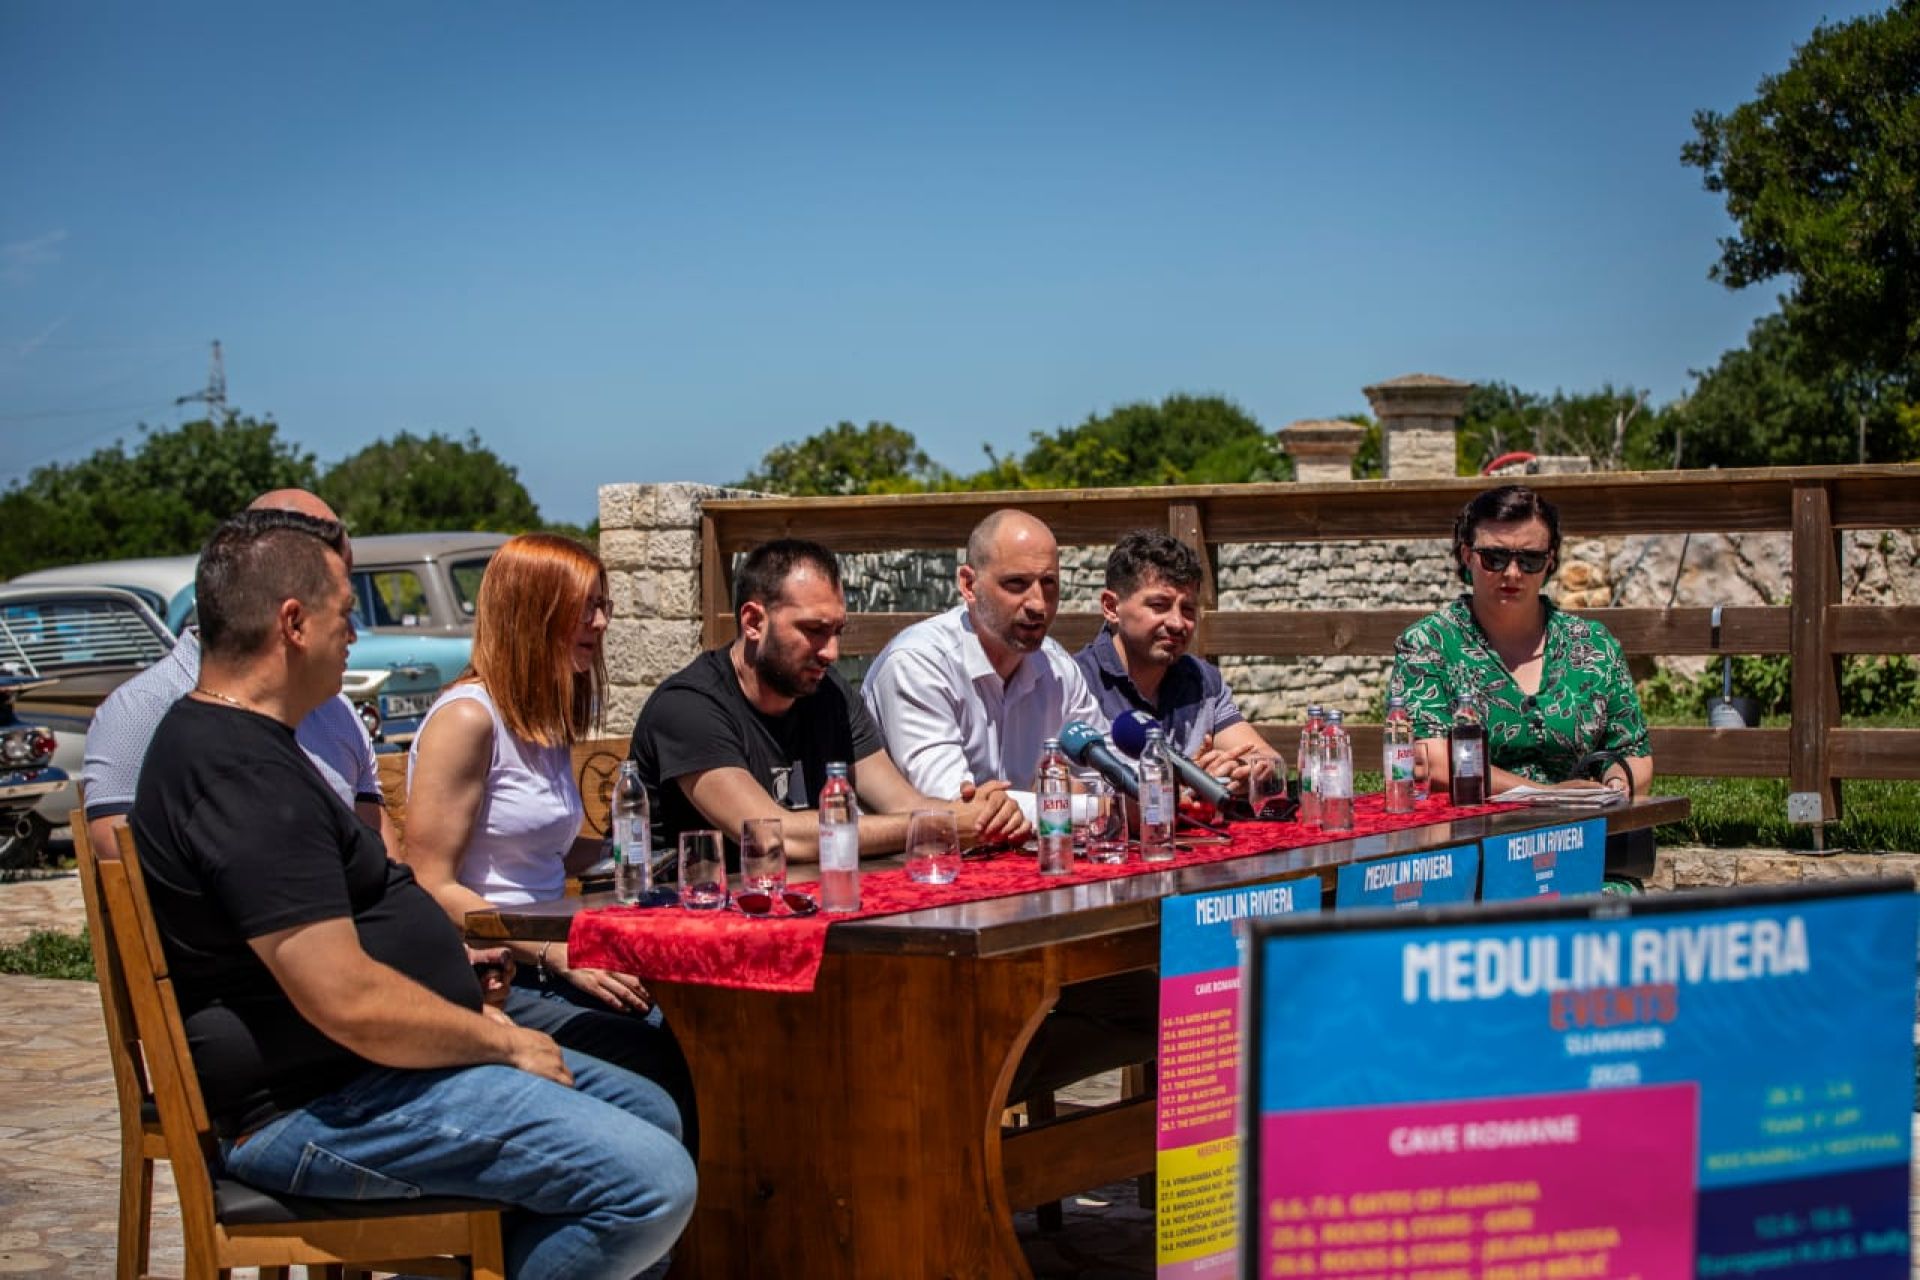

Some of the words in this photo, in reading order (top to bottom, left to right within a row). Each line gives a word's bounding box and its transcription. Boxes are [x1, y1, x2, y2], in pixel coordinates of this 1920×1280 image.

[1508, 833, 1546, 861] MEDULIN
[1547, 827, 1584, 852] RIVIERA
[1364, 861, 1411, 892] MEDULIN
[1412, 854, 1453, 881] RIVIERA
[1196, 892, 1248, 926] MEDULIN
[1250, 887, 1293, 917] RIVIERA
[1403, 931, 1620, 1004] MEDULIN
[1630, 916, 1810, 986] RIVIERA
[1549, 983, 1678, 1030] EVENTS
[1565, 1028, 1665, 1056] SUMMER
[1389, 1124, 1459, 1156] CAVE
[1463, 1115, 1580, 1150] ROMANE
